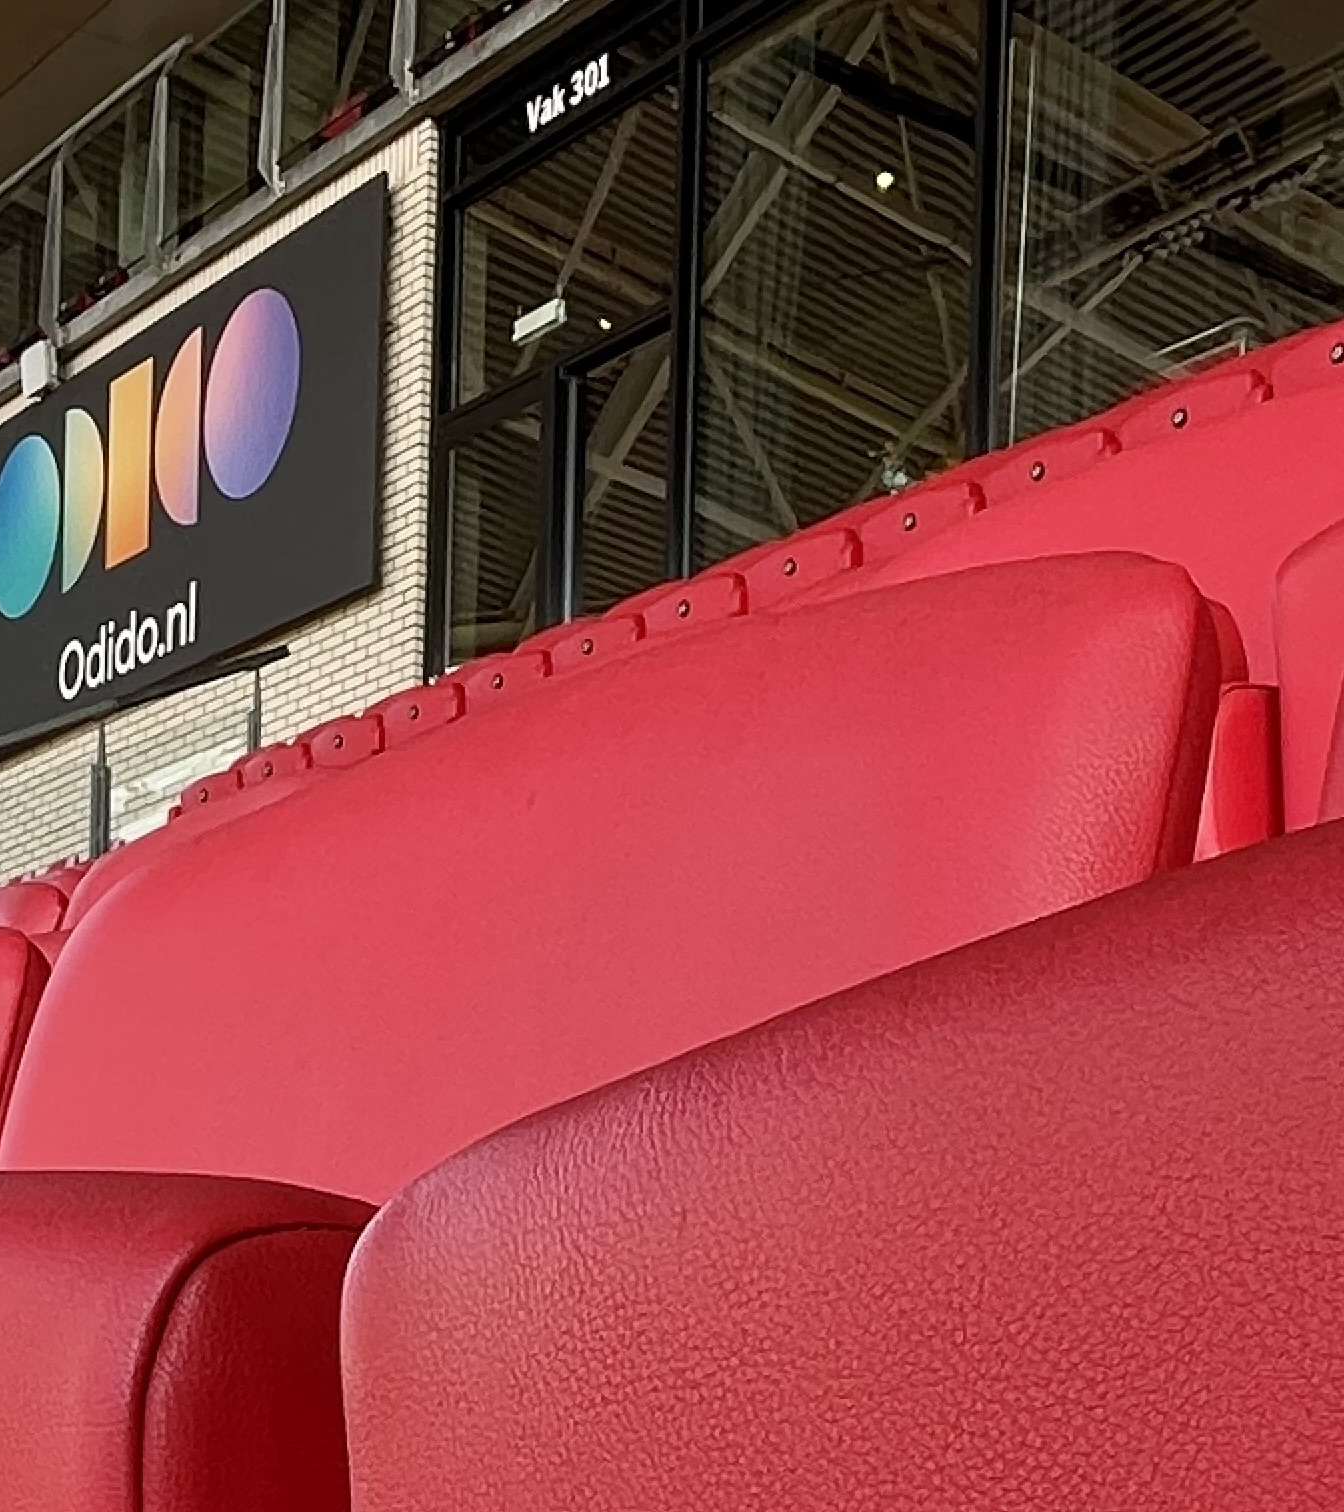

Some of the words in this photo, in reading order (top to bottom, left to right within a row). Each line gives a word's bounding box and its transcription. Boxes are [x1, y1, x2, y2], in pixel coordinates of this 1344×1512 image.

[526, 83, 565, 133] Vak
[569, 52, 610, 106] 301
[59, 580, 199, 700] Odido.nl
